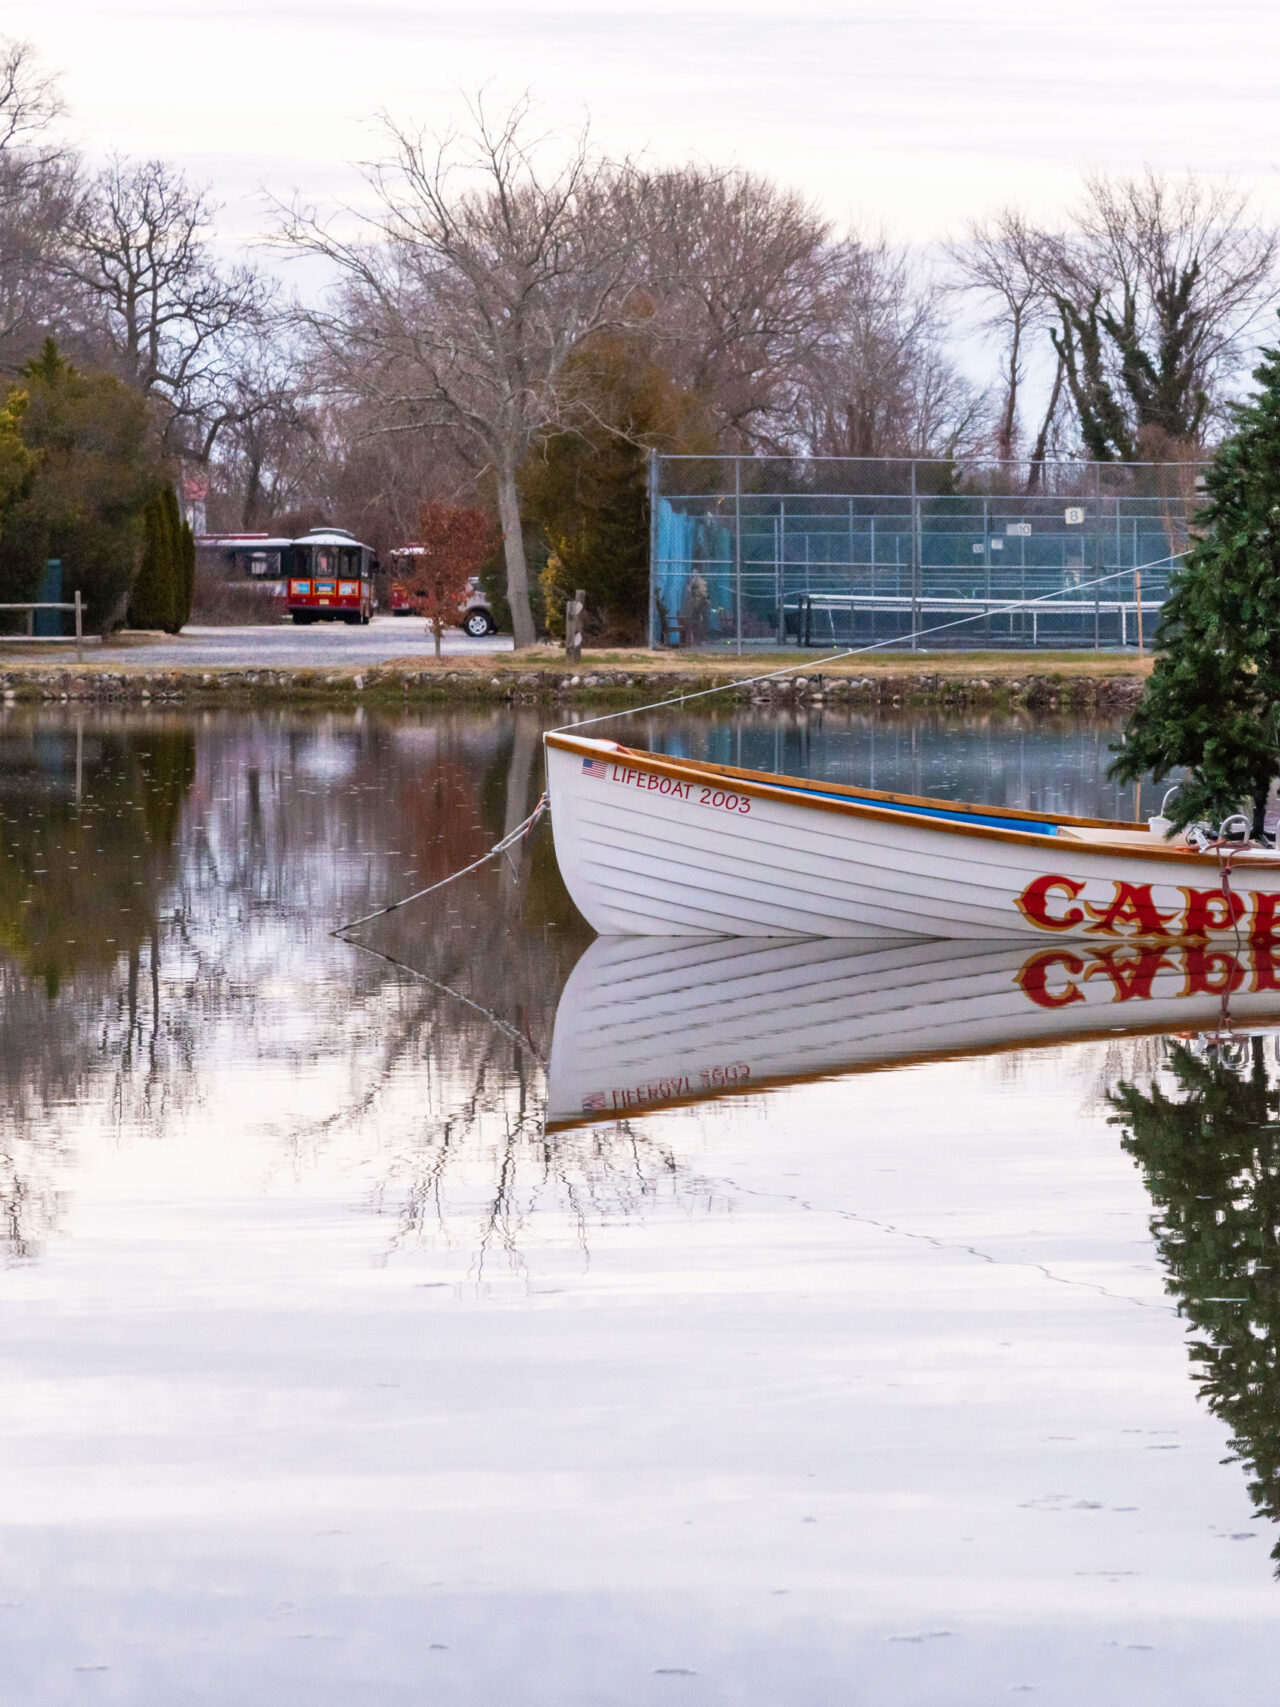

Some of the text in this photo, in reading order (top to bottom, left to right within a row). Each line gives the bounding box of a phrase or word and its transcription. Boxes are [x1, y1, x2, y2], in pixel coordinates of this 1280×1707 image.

[1070, 510, 1079, 521] 8
[1018, 525, 1031, 535] 10
[612, 765, 751, 813] LIFEBOAT 2003
